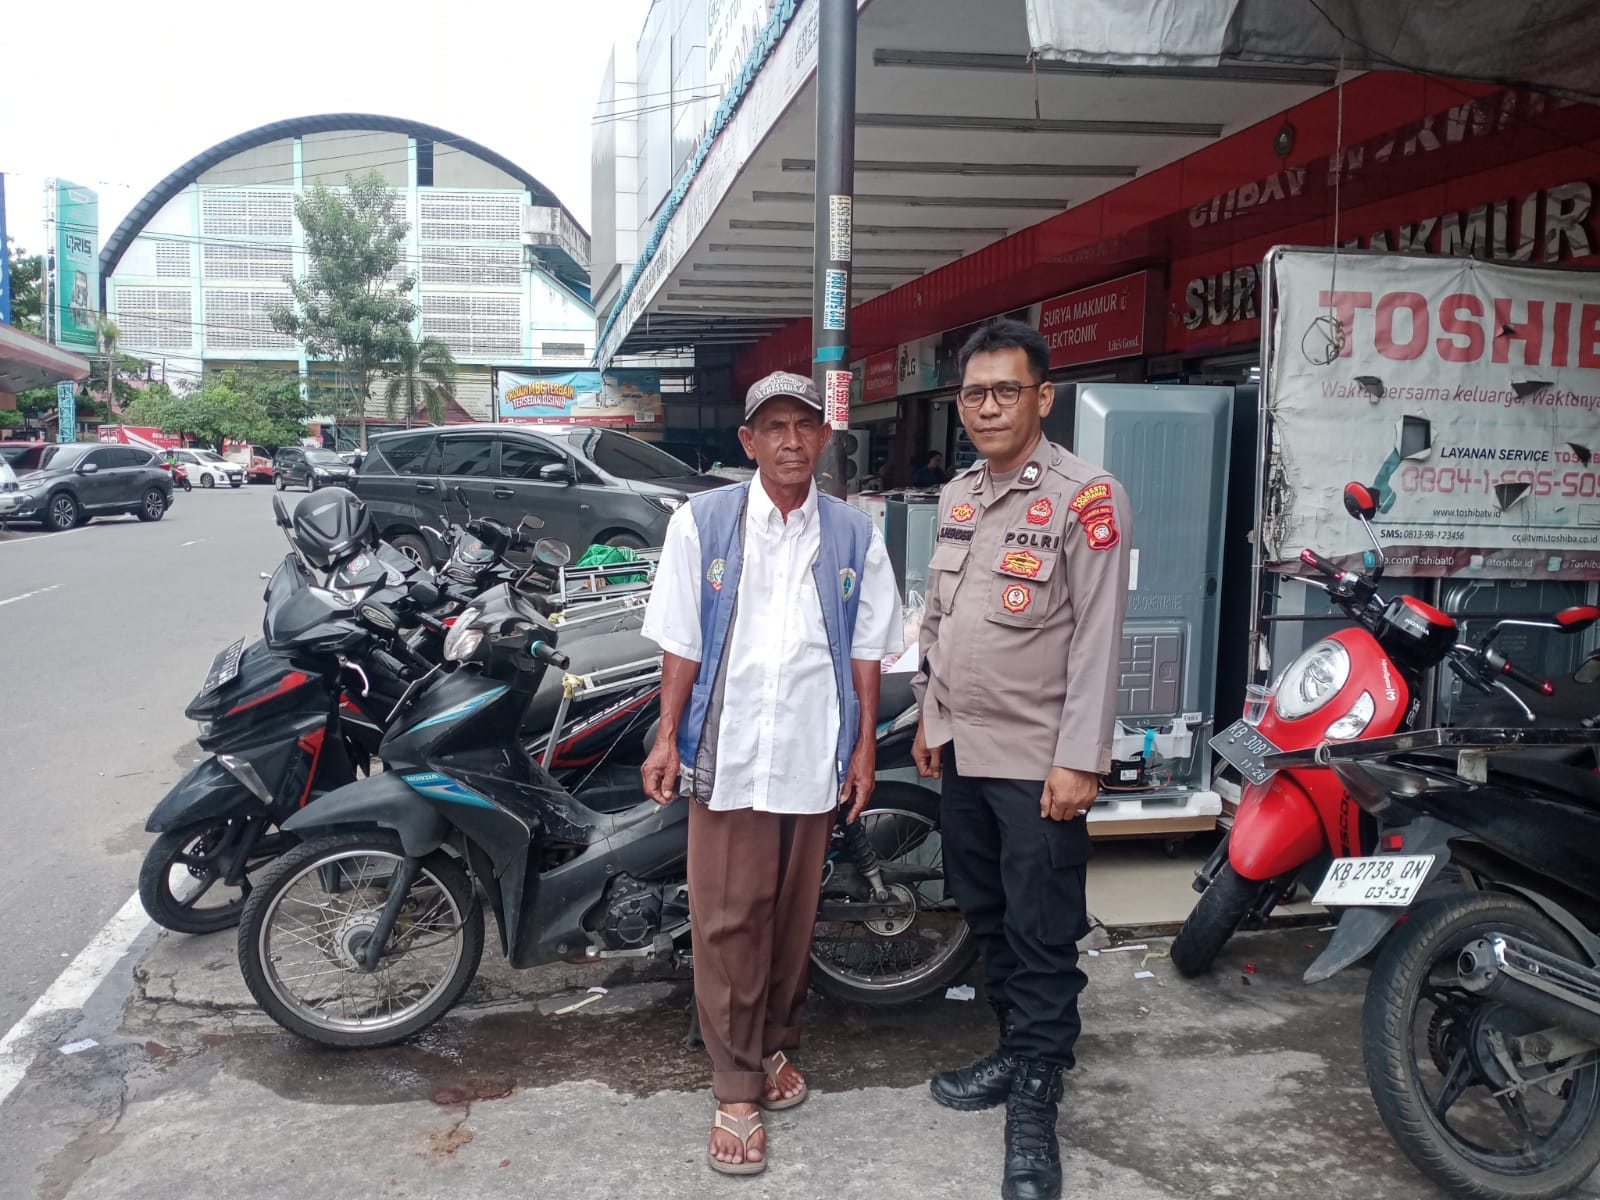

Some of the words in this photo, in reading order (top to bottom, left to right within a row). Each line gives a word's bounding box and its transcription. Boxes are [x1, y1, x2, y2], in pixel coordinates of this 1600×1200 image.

[1184, 262, 1263, 330] SUR
[1043, 305, 1071, 328] SURYA
[1073, 293, 1117, 320] MAKMUR
[1044, 323, 1098, 349] LEKTRONIK
[906, 358, 916, 376] LG
[1440, 447, 1497, 460] LAYANAN
[1498, 449, 1549, 462] SERVICE
[1004, 531, 1060, 550] POLRI
[1380, 529, 1402, 539] SMS:
[1403, 530, 1465, 541] 0813-98-123456
[1405, 617, 1429, 636] HONDA
[1228, 721, 1248, 738] KB
[406, 774, 439, 782] HONDA
[1330, 863, 1353, 881] KB
[1353, 861, 1395, 881] 2738
